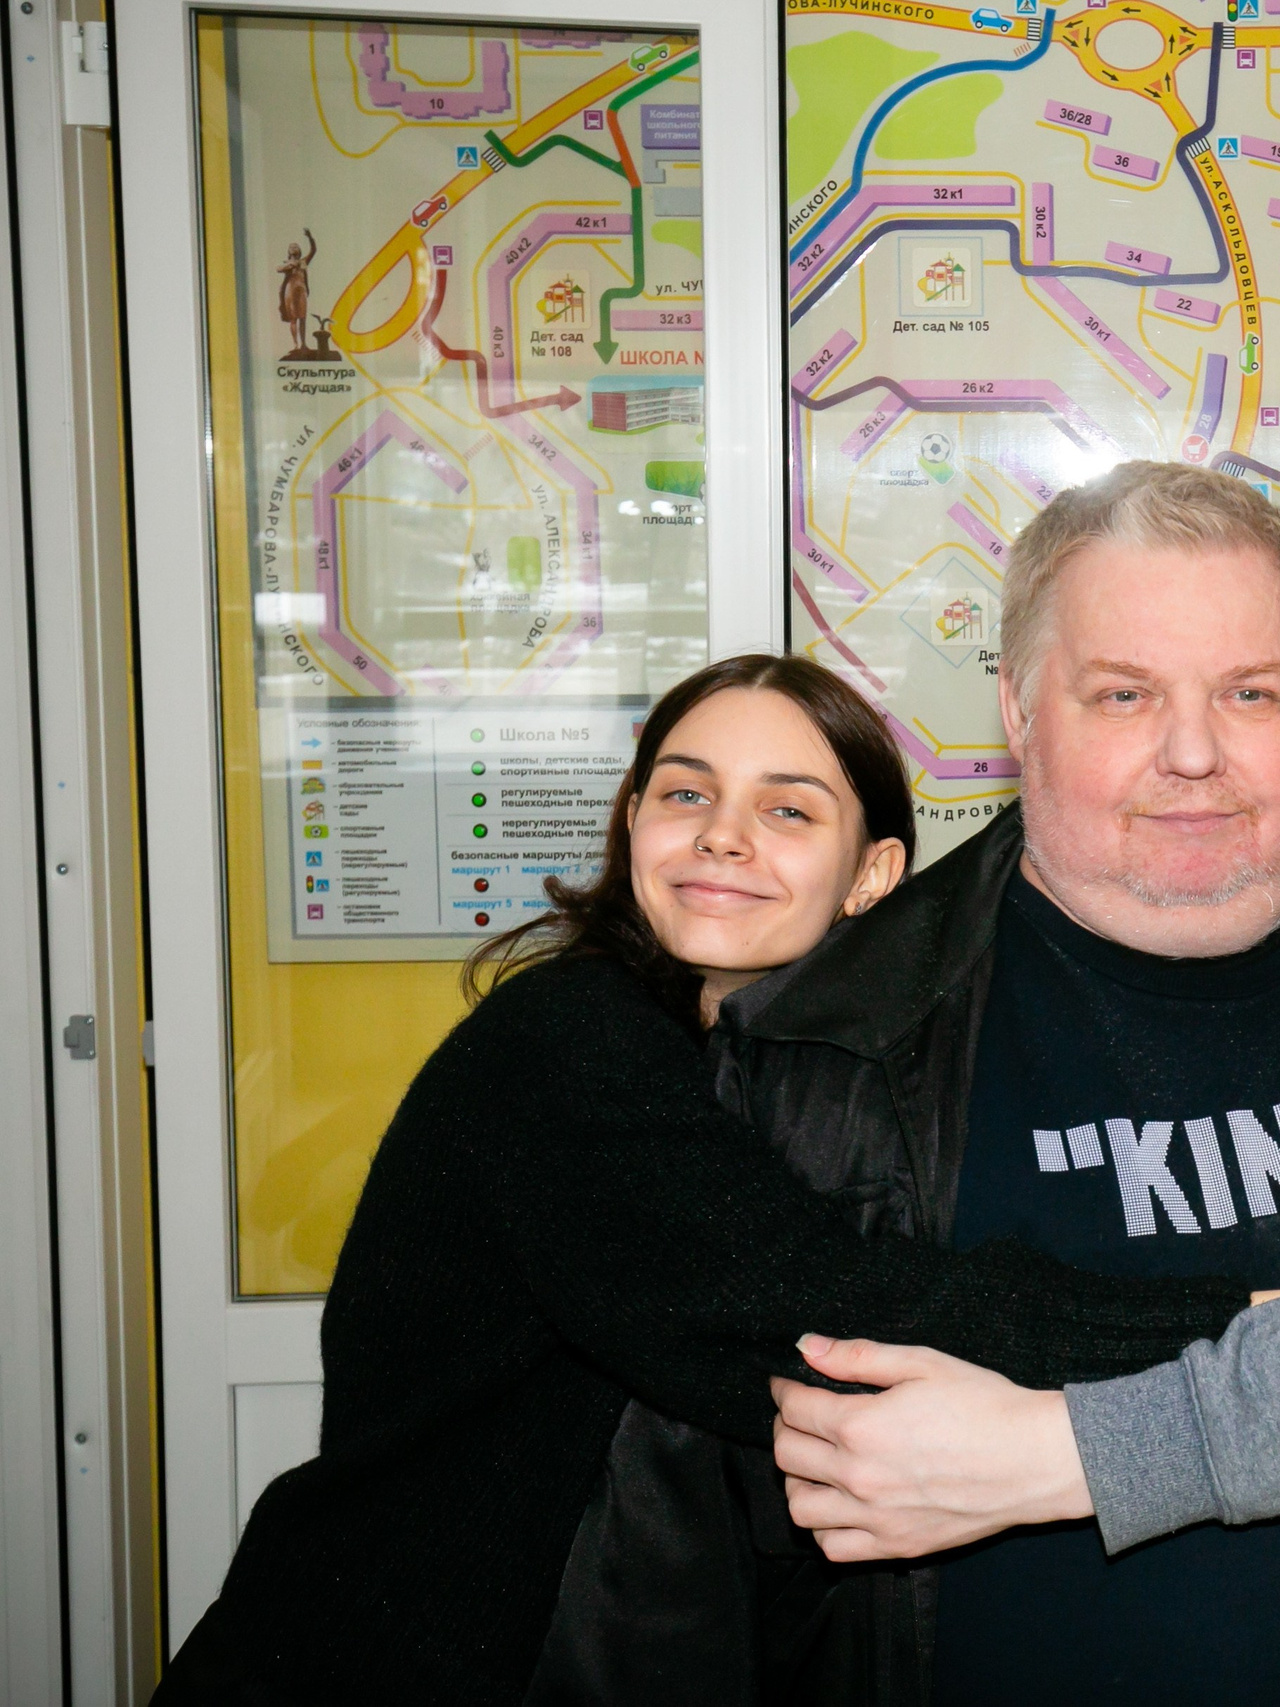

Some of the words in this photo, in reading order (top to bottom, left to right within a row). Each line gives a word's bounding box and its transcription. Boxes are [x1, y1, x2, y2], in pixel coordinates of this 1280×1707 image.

[369, 43, 376, 55] 1
[429, 98, 445, 109] 10
[649, 109, 699, 119] Комбинат
[1059, 108, 1092, 126] 36/28
[654, 131, 698, 141] питания
[1114, 155, 1130, 167] 36
[934, 188, 949, 200] 32
[950, 189, 964, 200] к1
[1036, 206, 1046, 221] 30
[575, 217, 591, 228] 42
[592, 217, 608, 228] к1
[1036, 223, 1047, 239] к2
[1201, 157, 1215, 179] ул.
[1213, 180, 1256, 326] АСКОЛЬДОВЦЕВ
[506, 249, 520, 266] 40
[517, 237, 532, 254] к2
[797, 254, 814, 272] 32
[810, 243, 826, 260] к2
[1126, 251, 1142, 263] 34
[655, 283, 677, 296] ул.
[1177, 297, 1192, 311] 22
[660, 314, 675, 325] 32
[677, 314, 692, 325] к3
[493, 326, 504, 341] 40
[893, 321, 919, 334] Дет.
[922, 322, 946, 333] сад
[949, 321, 965, 332] №
[968, 321, 990, 332] 105
[1084, 316, 1102, 334] 30
[1097, 327, 1112, 343] к1
[530, 331, 556, 343] Дет.
[560, 332, 585, 344] сад
[531, 345, 547, 357] №
[550, 345, 573, 357] 108
[620, 350, 689, 365] ШКОЛА
[806, 359, 824, 377] 32
[819, 349, 834, 366] к2
[277, 366, 356, 382] Скульптура
[282, 381, 352, 396] «Ждущая»
[962, 382, 977, 394] 26
[979, 382, 994, 394] к2
[859, 422, 877, 440] 26
[871, 410, 887, 428] к3
[1199, 413, 1212, 430] 28
[528, 434, 543, 448] 34
[541, 445, 556, 462] к2
[337, 457, 352, 473] 46
[1036, 484, 1053, 501] 22
[582, 530, 592, 545] 34
[318, 540, 330, 555] 48
[988, 540, 1003, 555] 18
[807, 547, 821, 563] 30
[819, 559, 835, 574] к1
[263, 456, 324, 686] ЧУМБАРОВА-ЛУНСКОГО
[583, 617, 597, 628] 36
[353, 655, 368, 670] 50
[978, 651, 1000, 662] Дет
[500, 728, 556, 742] Школа
[561, 728, 590, 741] №5
[500, 757, 540, 767] школы,
[545, 757, 589, 766] детские
[592, 757, 625, 767] сады,
[973, 762, 988, 773] 26
[500, 767, 569, 777] спортивные
[501, 788, 583, 799] регулируемые
[501, 798, 573, 808] пешеходные
[915, 801, 1005, 822] АНДРОВА
[502, 819, 597, 831] нерегулируемые
[502, 829, 574, 839] пешеходные
[451, 851, 519, 861] безопасные
[522, 851, 582, 862] маршруты
[452, 865, 501, 876] маршрут
[521, 865, 570, 875] маршрут
[453, 899, 502, 909] маршрут
